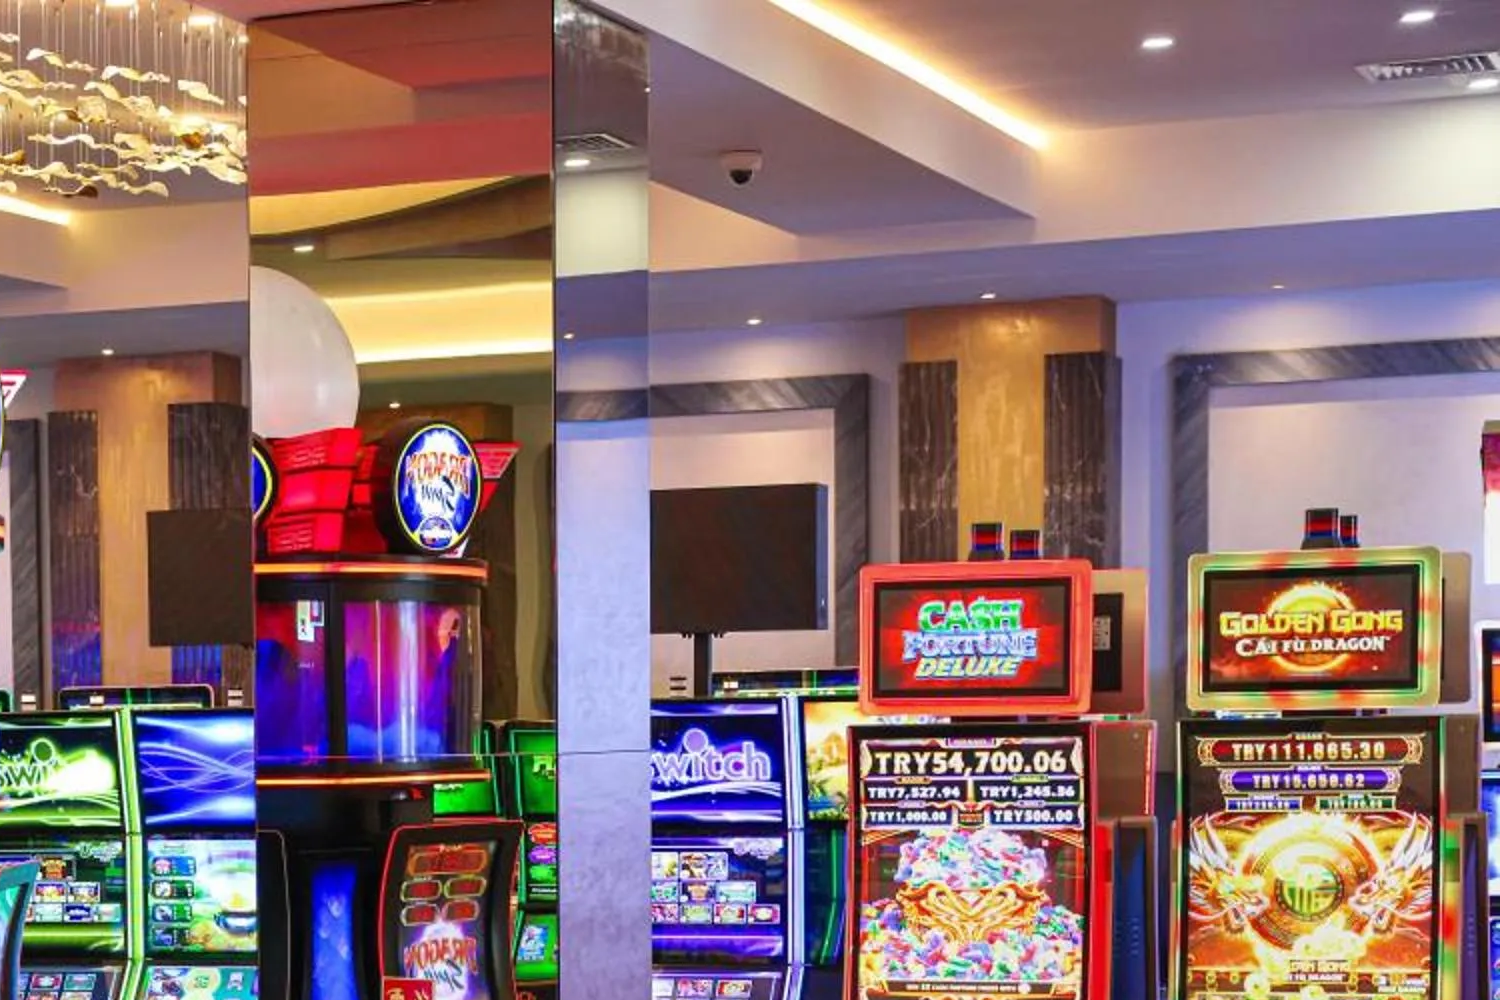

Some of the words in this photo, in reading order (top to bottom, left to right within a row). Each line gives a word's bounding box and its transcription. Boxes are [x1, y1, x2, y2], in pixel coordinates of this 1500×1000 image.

[1219, 610, 1325, 637] GOLDEN
[1330, 609, 1404, 634] GONG
[902, 628, 1040, 660] FORTUNE
[914, 657, 1021, 680] DELUXE
[651, 728, 772, 784] witch
[874, 751, 1068, 777] TRY54,700.06
[993, 809, 1073, 823] TRY500.00
